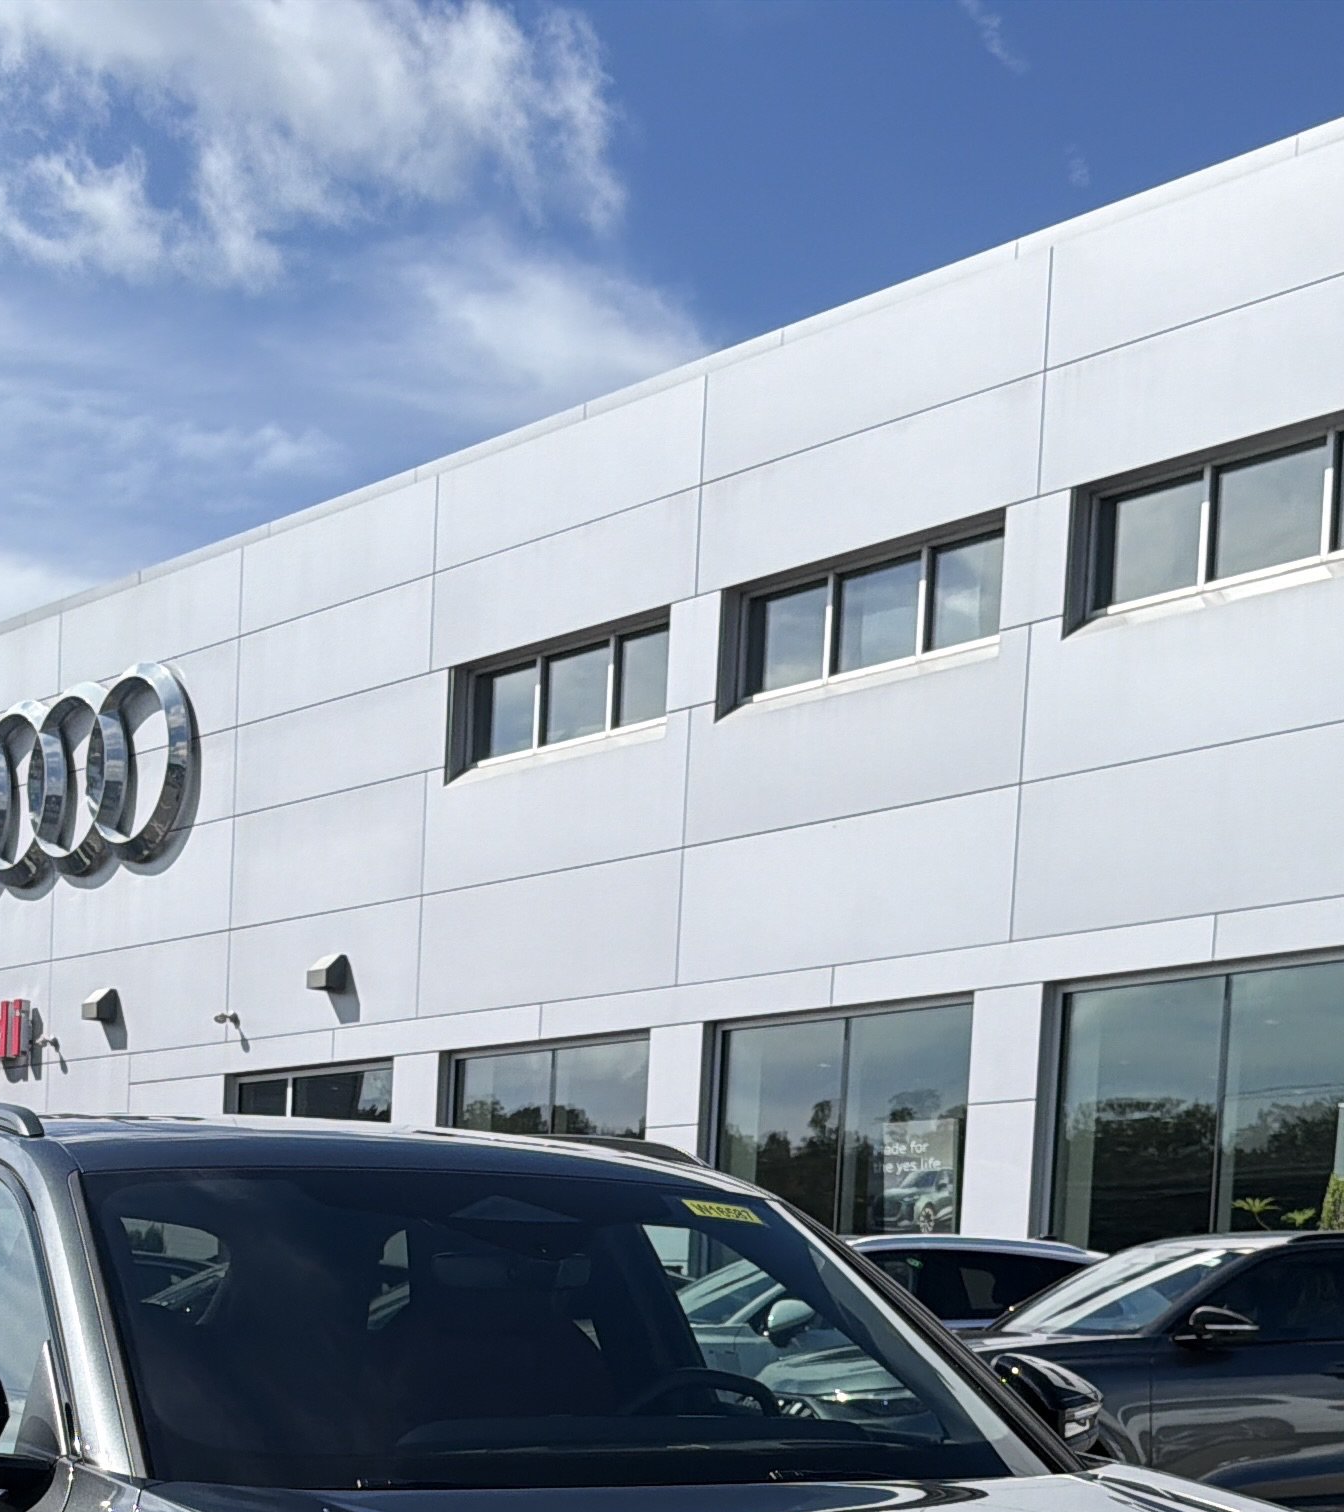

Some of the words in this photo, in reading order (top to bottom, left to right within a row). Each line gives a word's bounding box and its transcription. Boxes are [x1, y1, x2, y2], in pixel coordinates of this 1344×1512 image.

[909, 1141, 930, 1154] for
[895, 1160, 917, 1176] yes
[920, 1156, 942, 1170] life
